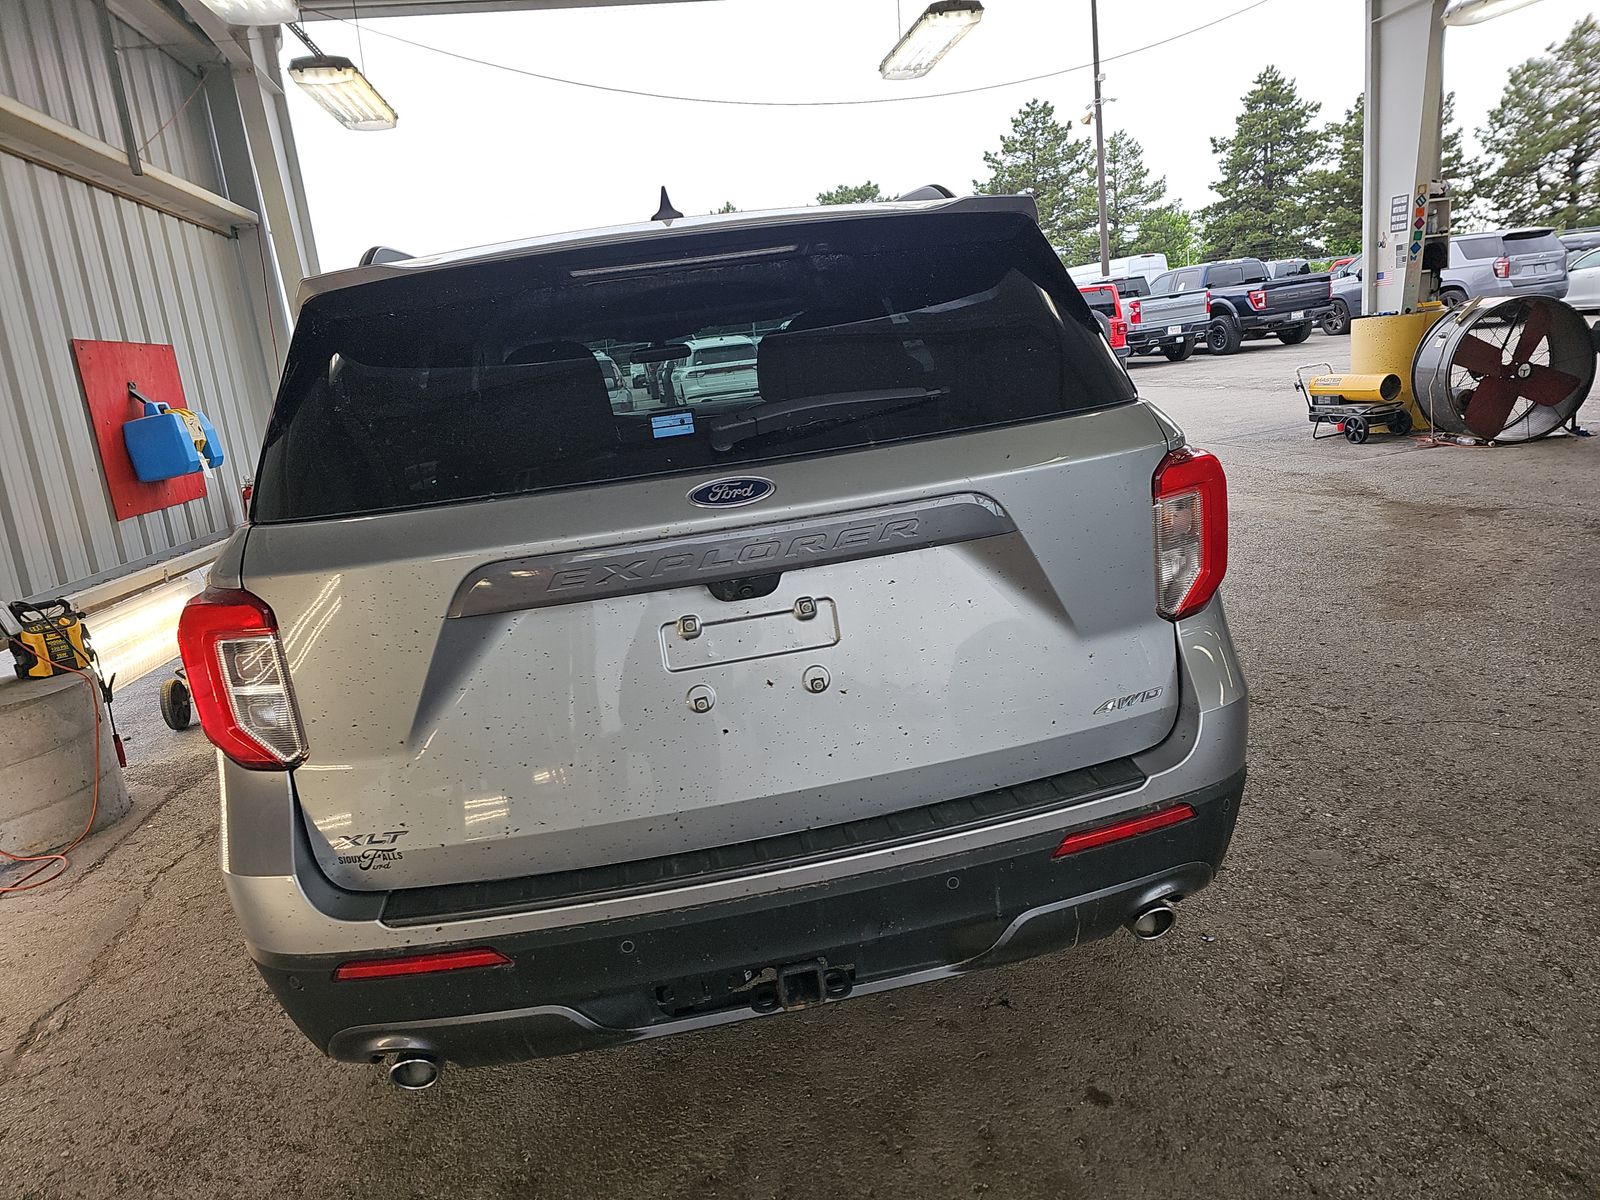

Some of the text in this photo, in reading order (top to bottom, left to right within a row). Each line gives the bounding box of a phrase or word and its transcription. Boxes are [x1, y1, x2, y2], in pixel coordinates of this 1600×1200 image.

[709, 481, 754, 501] Ford
[546, 517, 920, 592] EXPLORER
[1093, 686, 1163, 715] 4WD
[332, 830, 409, 850] XLT
[338, 855, 362, 865] SIOUX
